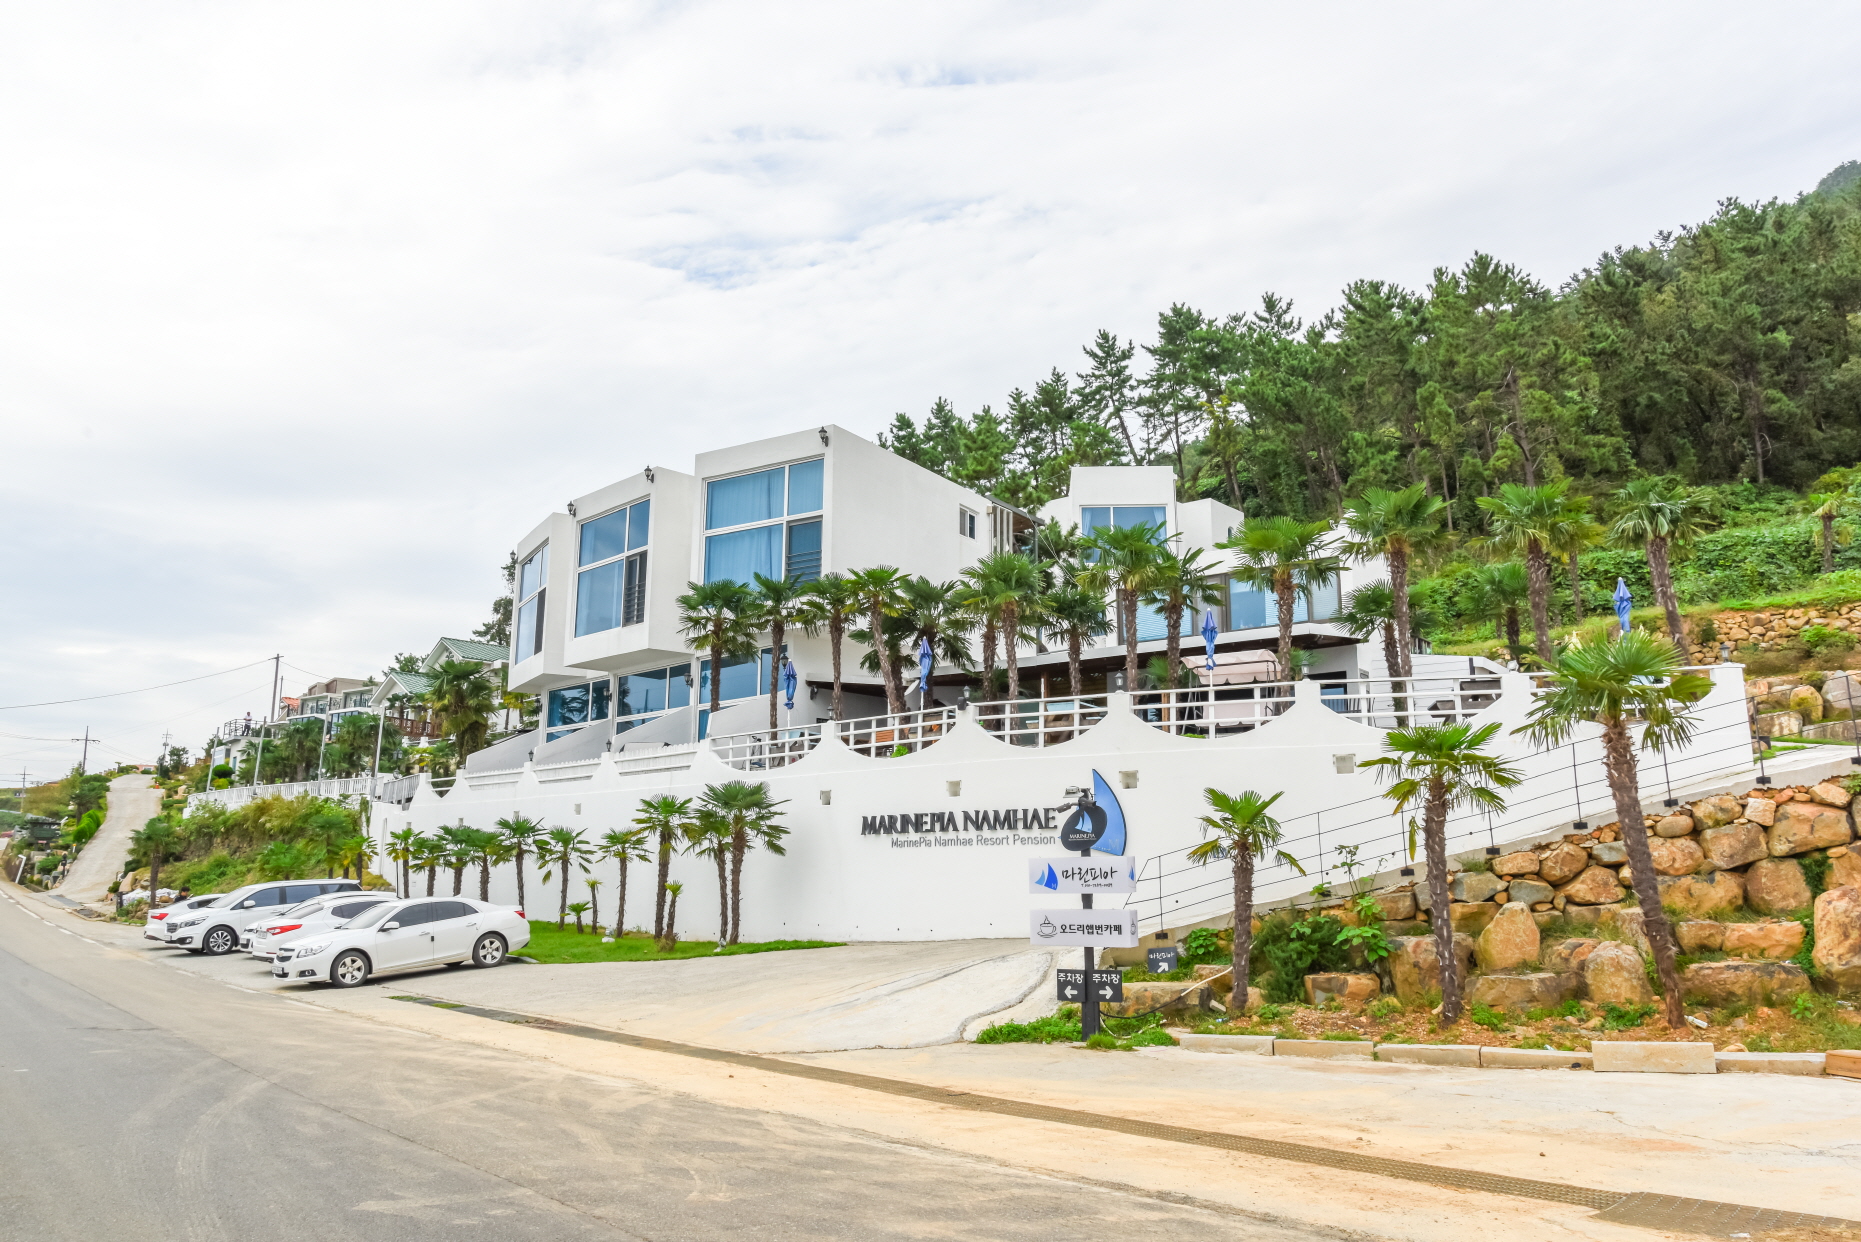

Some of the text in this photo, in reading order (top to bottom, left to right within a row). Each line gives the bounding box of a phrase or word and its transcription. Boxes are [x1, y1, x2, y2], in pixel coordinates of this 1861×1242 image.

[861, 807, 1057, 835] MARINEPIA NAMHAE
[891, 833, 1055, 848] MarinePia Namhae Resort Pension
[1062, 866, 1118, 883] 마린피아
[1060, 924, 1122, 935] 오드리헵번카페
[1058, 972, 1084, 984] 주차장
[1092, 973, 1120, 984] 주차장
